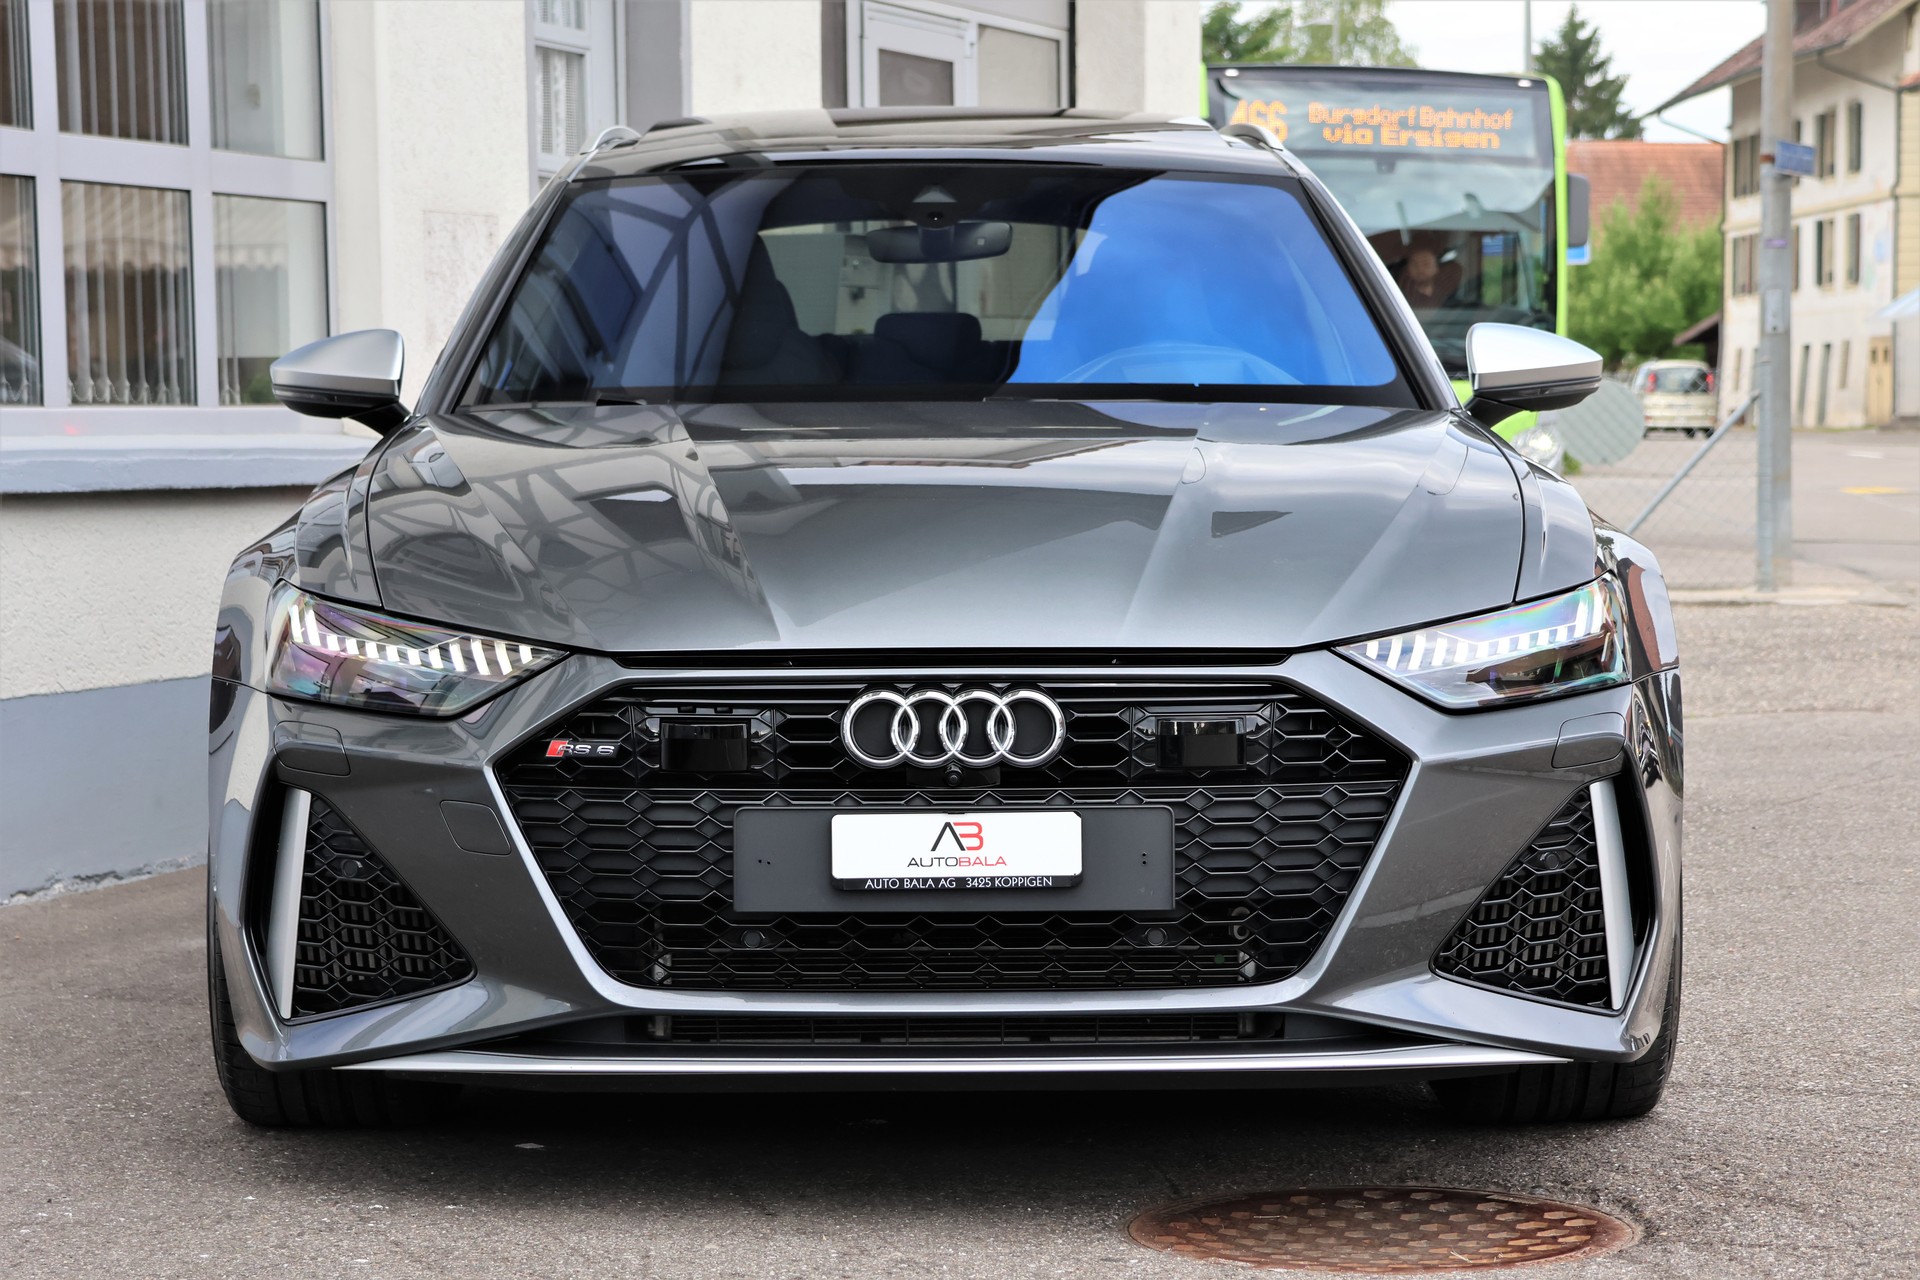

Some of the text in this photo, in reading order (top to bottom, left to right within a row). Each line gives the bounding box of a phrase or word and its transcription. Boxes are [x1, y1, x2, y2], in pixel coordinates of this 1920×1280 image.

[1420, 105, 1513, 129] Bahnhof
[1323, 124, 1373, 144] via
[556, 744, 615, 755] RS 6
[907, 856, 1007, 868] AUTOBALA
[865, 876, 1052, 889] AUTO BALA AG 3425 KOPPIGEN
